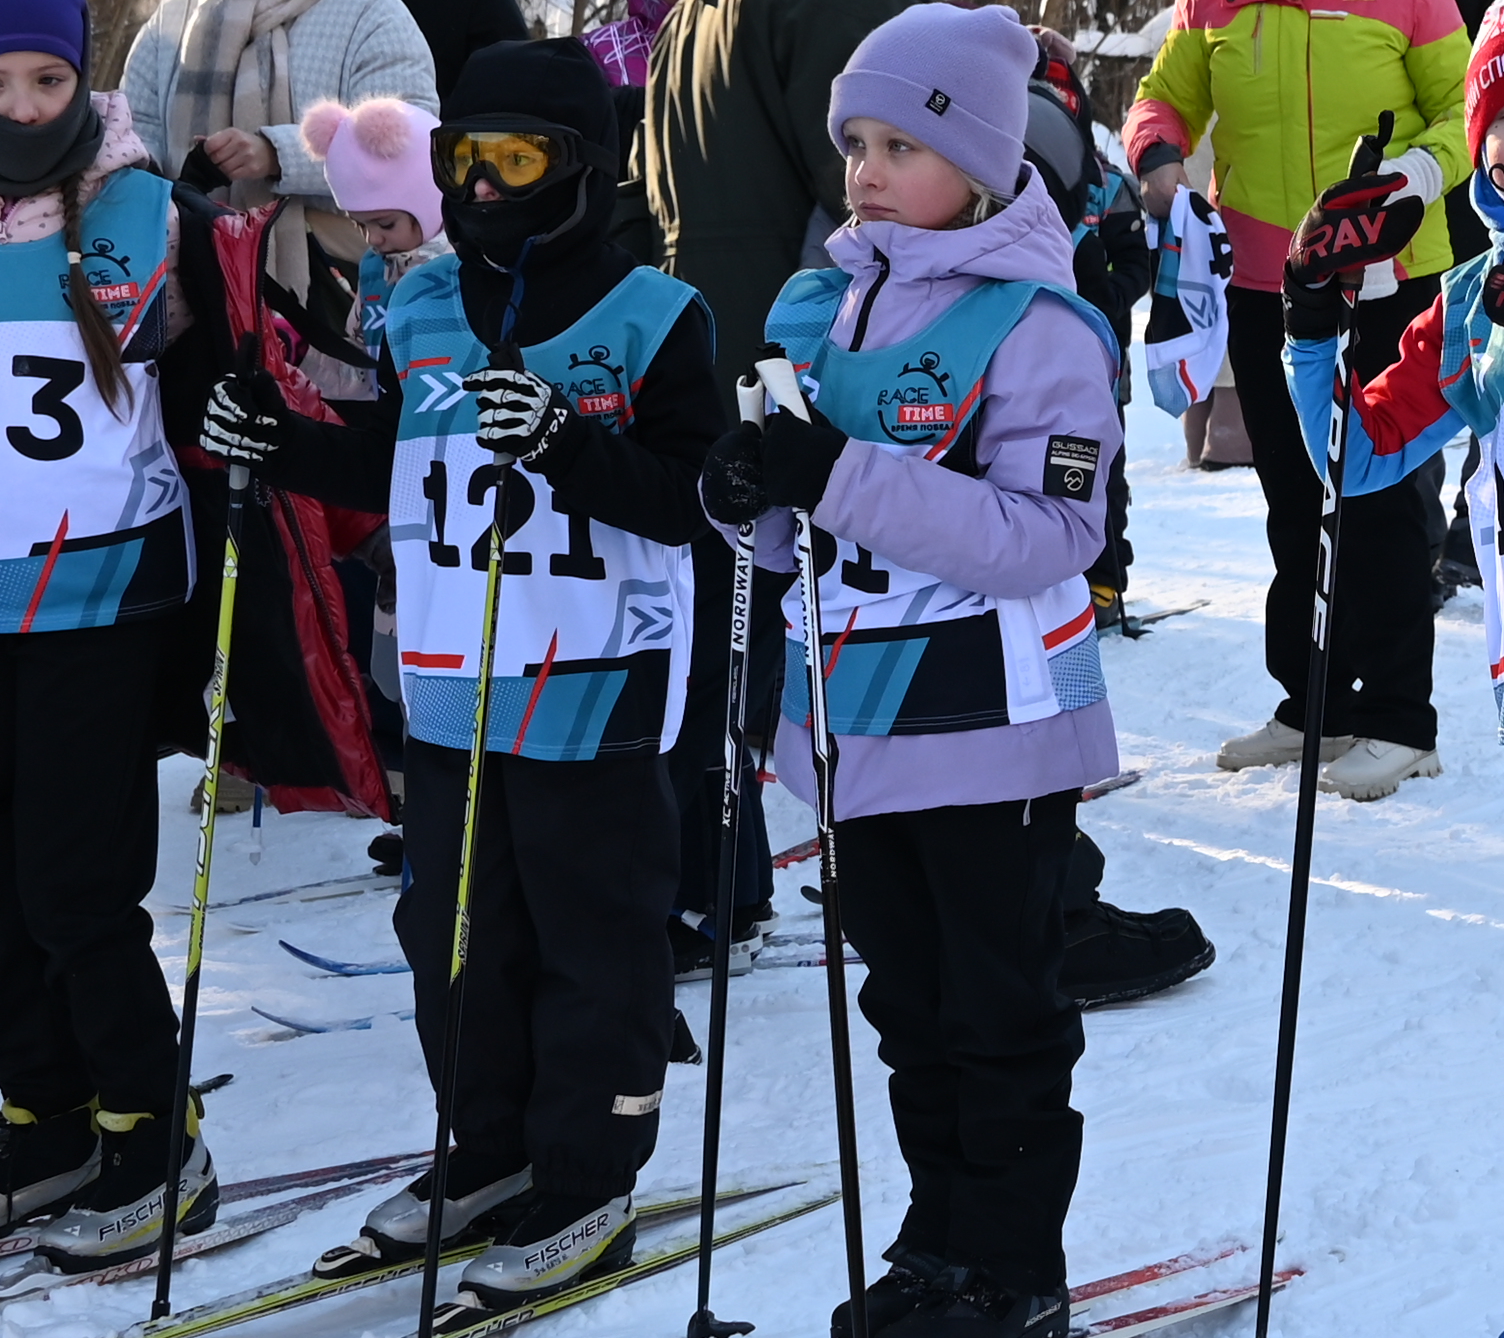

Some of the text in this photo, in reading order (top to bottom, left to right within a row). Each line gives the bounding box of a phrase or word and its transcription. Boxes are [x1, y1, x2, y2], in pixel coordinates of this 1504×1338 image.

[58, 269, 112, 290] RCE
[90, 284, 131, 302] TIME
[584, 394, 619, 412] TIME
[877, 386, 930, 406] RACE
[903, 406, 946, 422] TIME
[423, 460, 607, 580] 121
[731, 552, 751, 646] NORDWAY
[213, 647, 228, 698] SPRINT
[828, 827, 837, 879] NORDWAY
[98, 1178, 189, 1243] FISCHR
[523, 1211, 612, 1272] FISCHER
[65, 1257, 154, 1288] OKO
